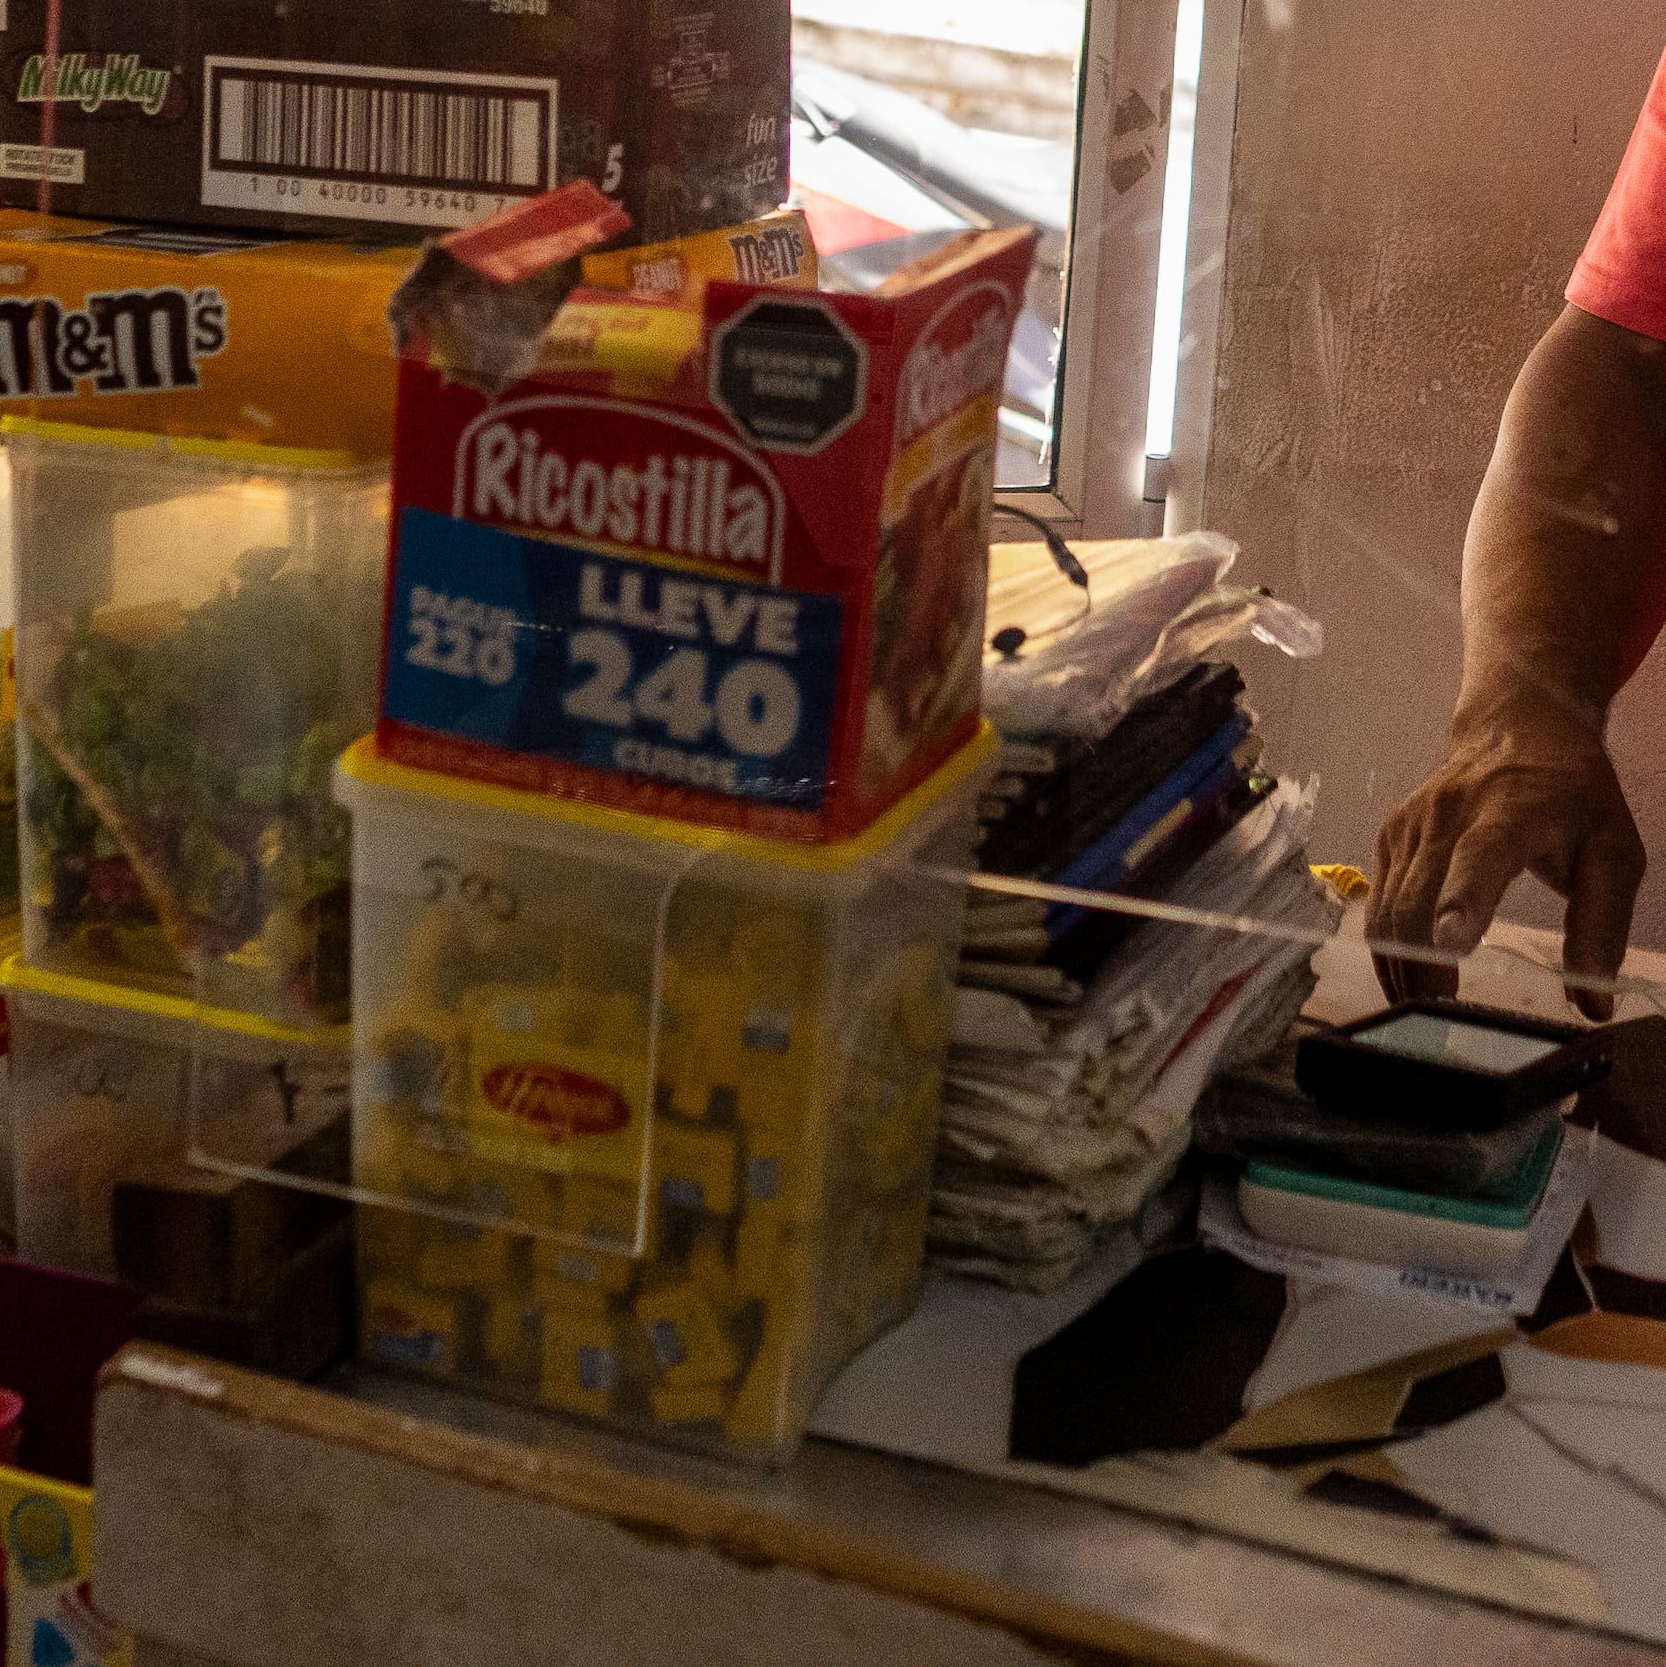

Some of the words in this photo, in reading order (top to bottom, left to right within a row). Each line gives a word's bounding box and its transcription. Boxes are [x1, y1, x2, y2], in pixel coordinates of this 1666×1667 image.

[746, 113, 777, 148] fun
[276, 178, 301, 196] 00
[318, 181, 387, 206] 40000
[405, 189, 476, 212] 59640
[471, 421, 769, 563] Ricostilla
[578, 563, 801, 656] LLEVE
[562, 626, 801, 759] 240
